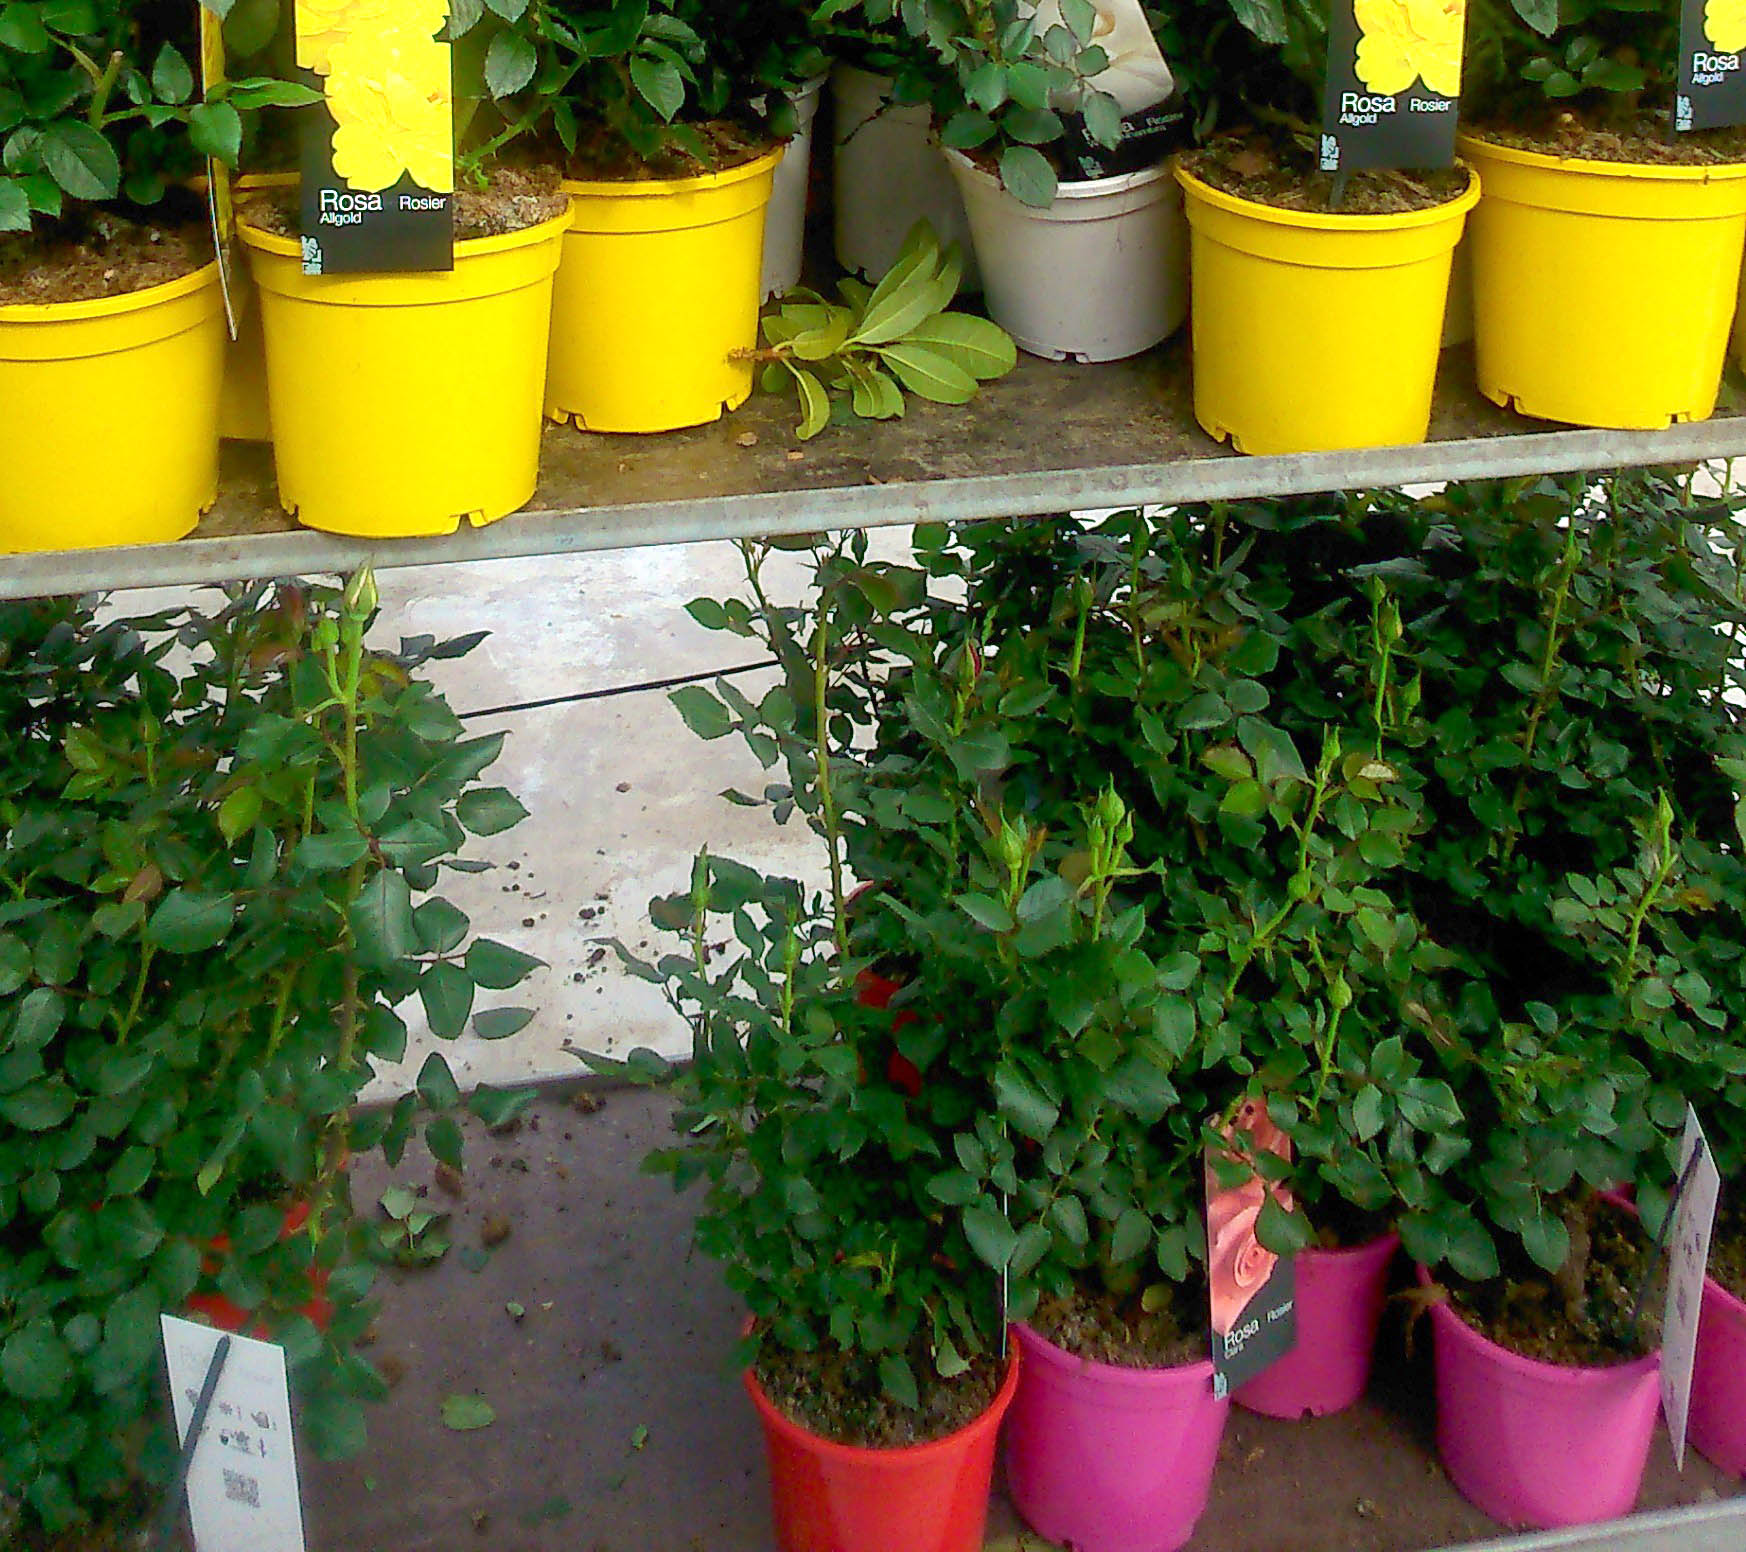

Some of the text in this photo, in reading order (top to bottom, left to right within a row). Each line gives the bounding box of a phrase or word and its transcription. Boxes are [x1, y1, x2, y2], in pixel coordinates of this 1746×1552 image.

[1693, 52, 1740, 72] Rosa
[1341, 92, 1452, 113] Rosa Rosier
[1338, 113, 1377, 126] Allgold
[319, 189, 447, 212] Rosa Rosier
[319, 211, 363, 227] Allgold
[1224, 1319, 1260, 1350] Rosa
